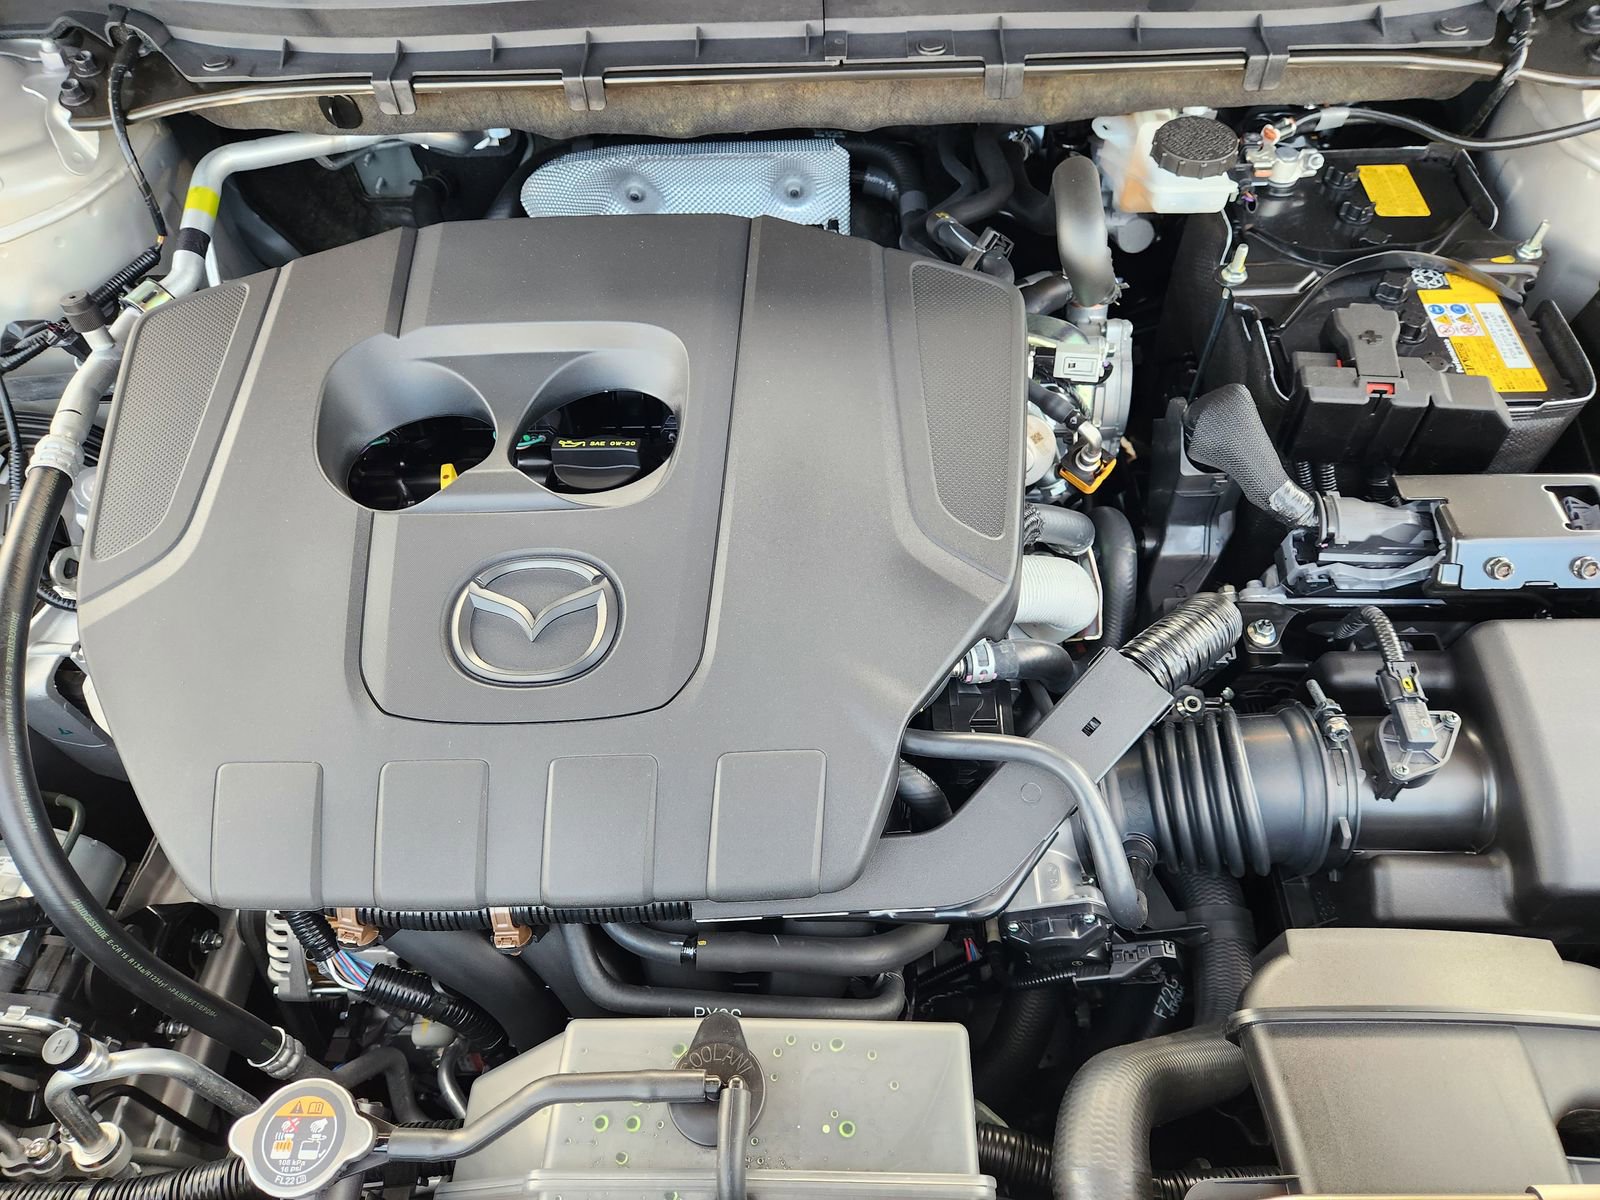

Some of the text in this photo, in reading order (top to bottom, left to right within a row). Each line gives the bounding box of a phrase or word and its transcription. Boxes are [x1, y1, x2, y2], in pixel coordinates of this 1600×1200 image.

[6, 611, 20, 663] BRIDGESTONE
[71, 898, 110, 940] BRIDGESTONE
[120, 952, 130, 960] 15
[292, 1159, 306, 1167] kPa
[274, 1175, 296, 1185] FL22
